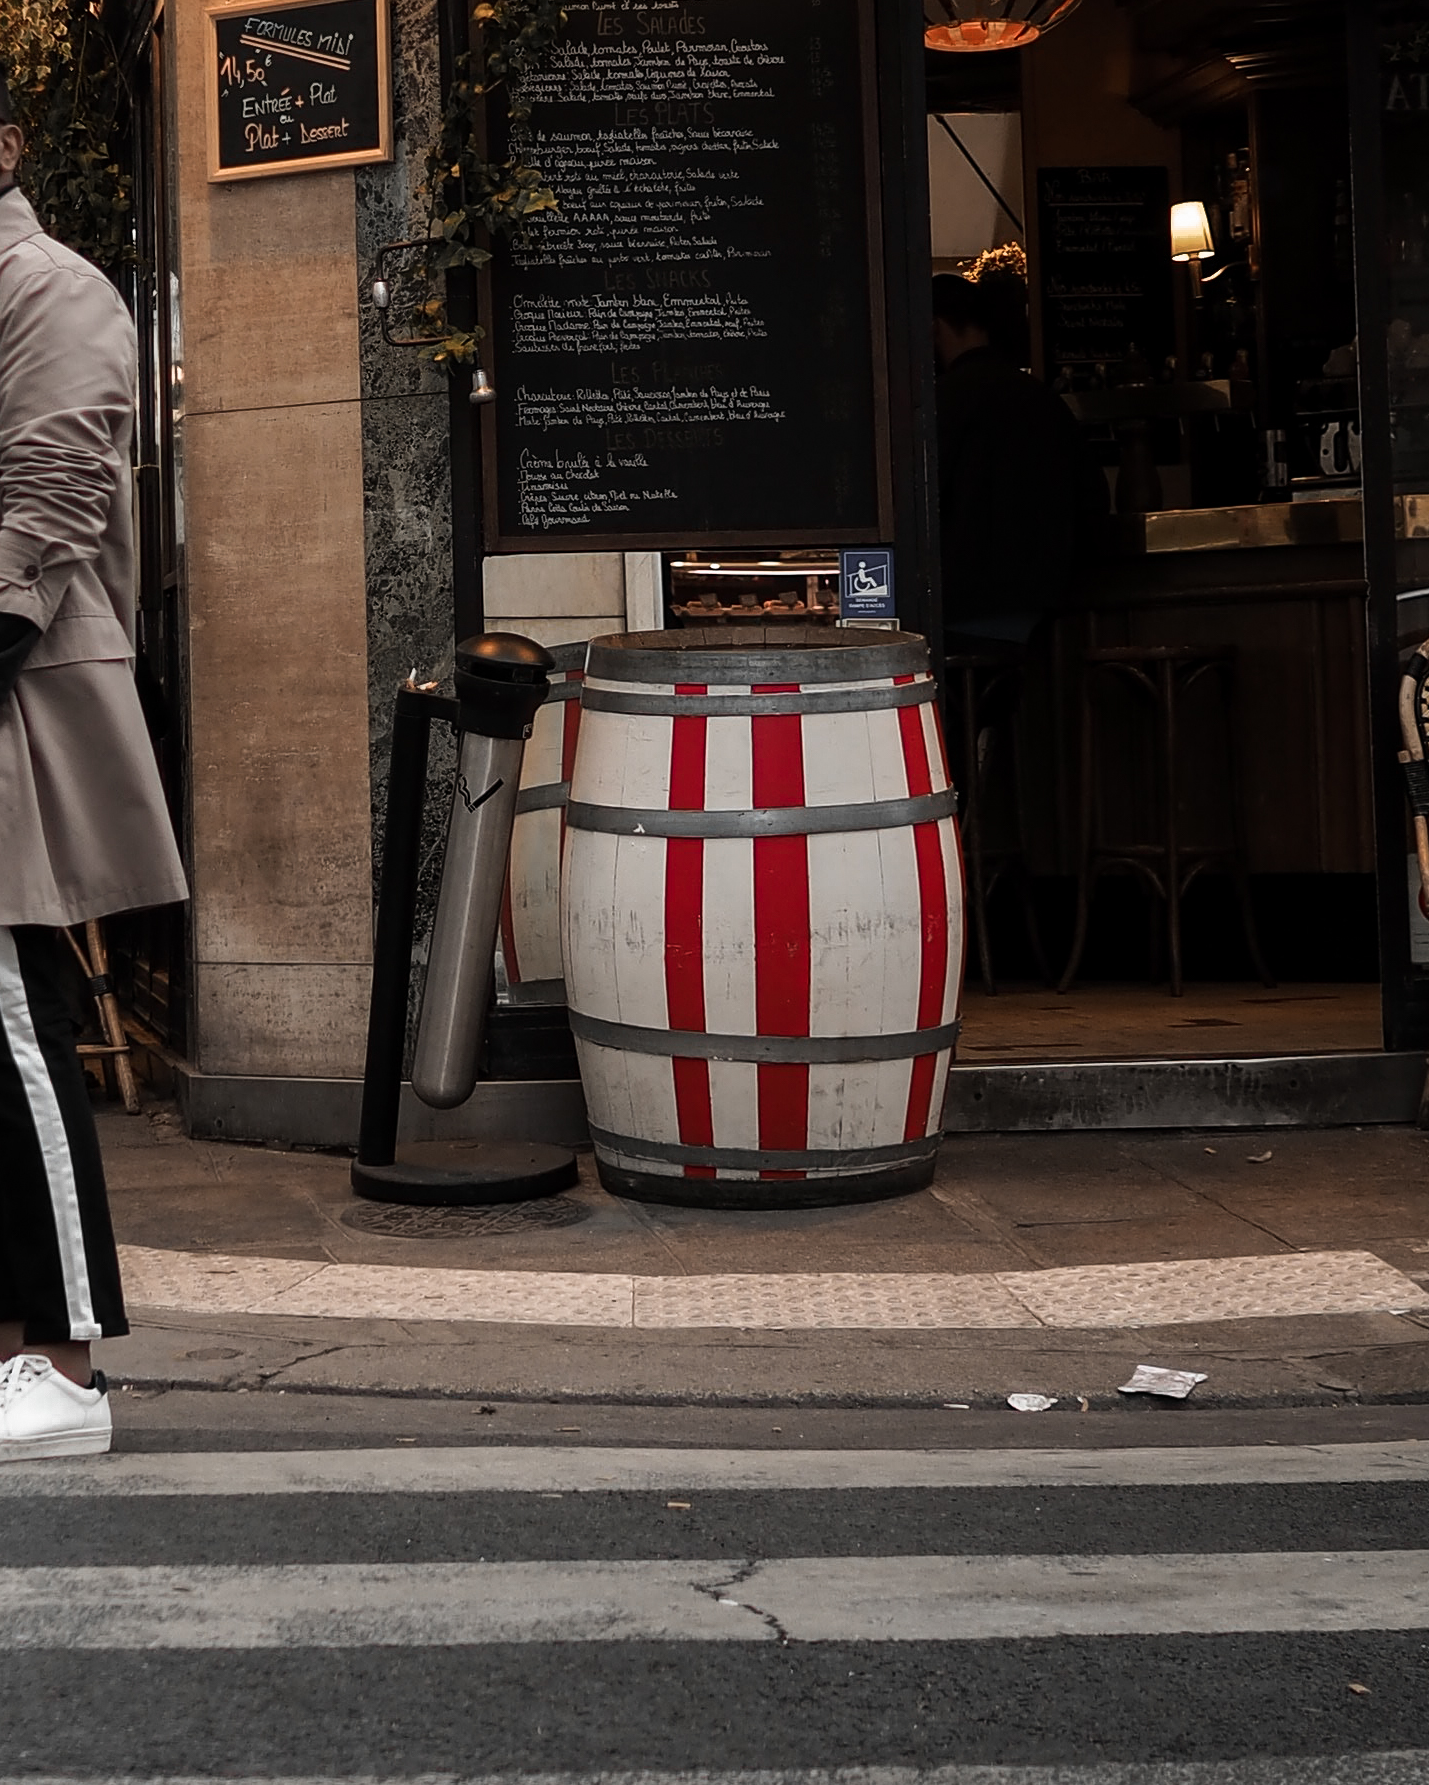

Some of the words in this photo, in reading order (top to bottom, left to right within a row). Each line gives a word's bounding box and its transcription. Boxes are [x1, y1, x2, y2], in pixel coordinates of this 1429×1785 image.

[244, 17, 314, 47] FORMULES
[597, 12, 624, 36] LES
[309, 82, 338, 106] Plat
[615, 102, 649, 126] LES
[244, 122, 279, 152] Plat
